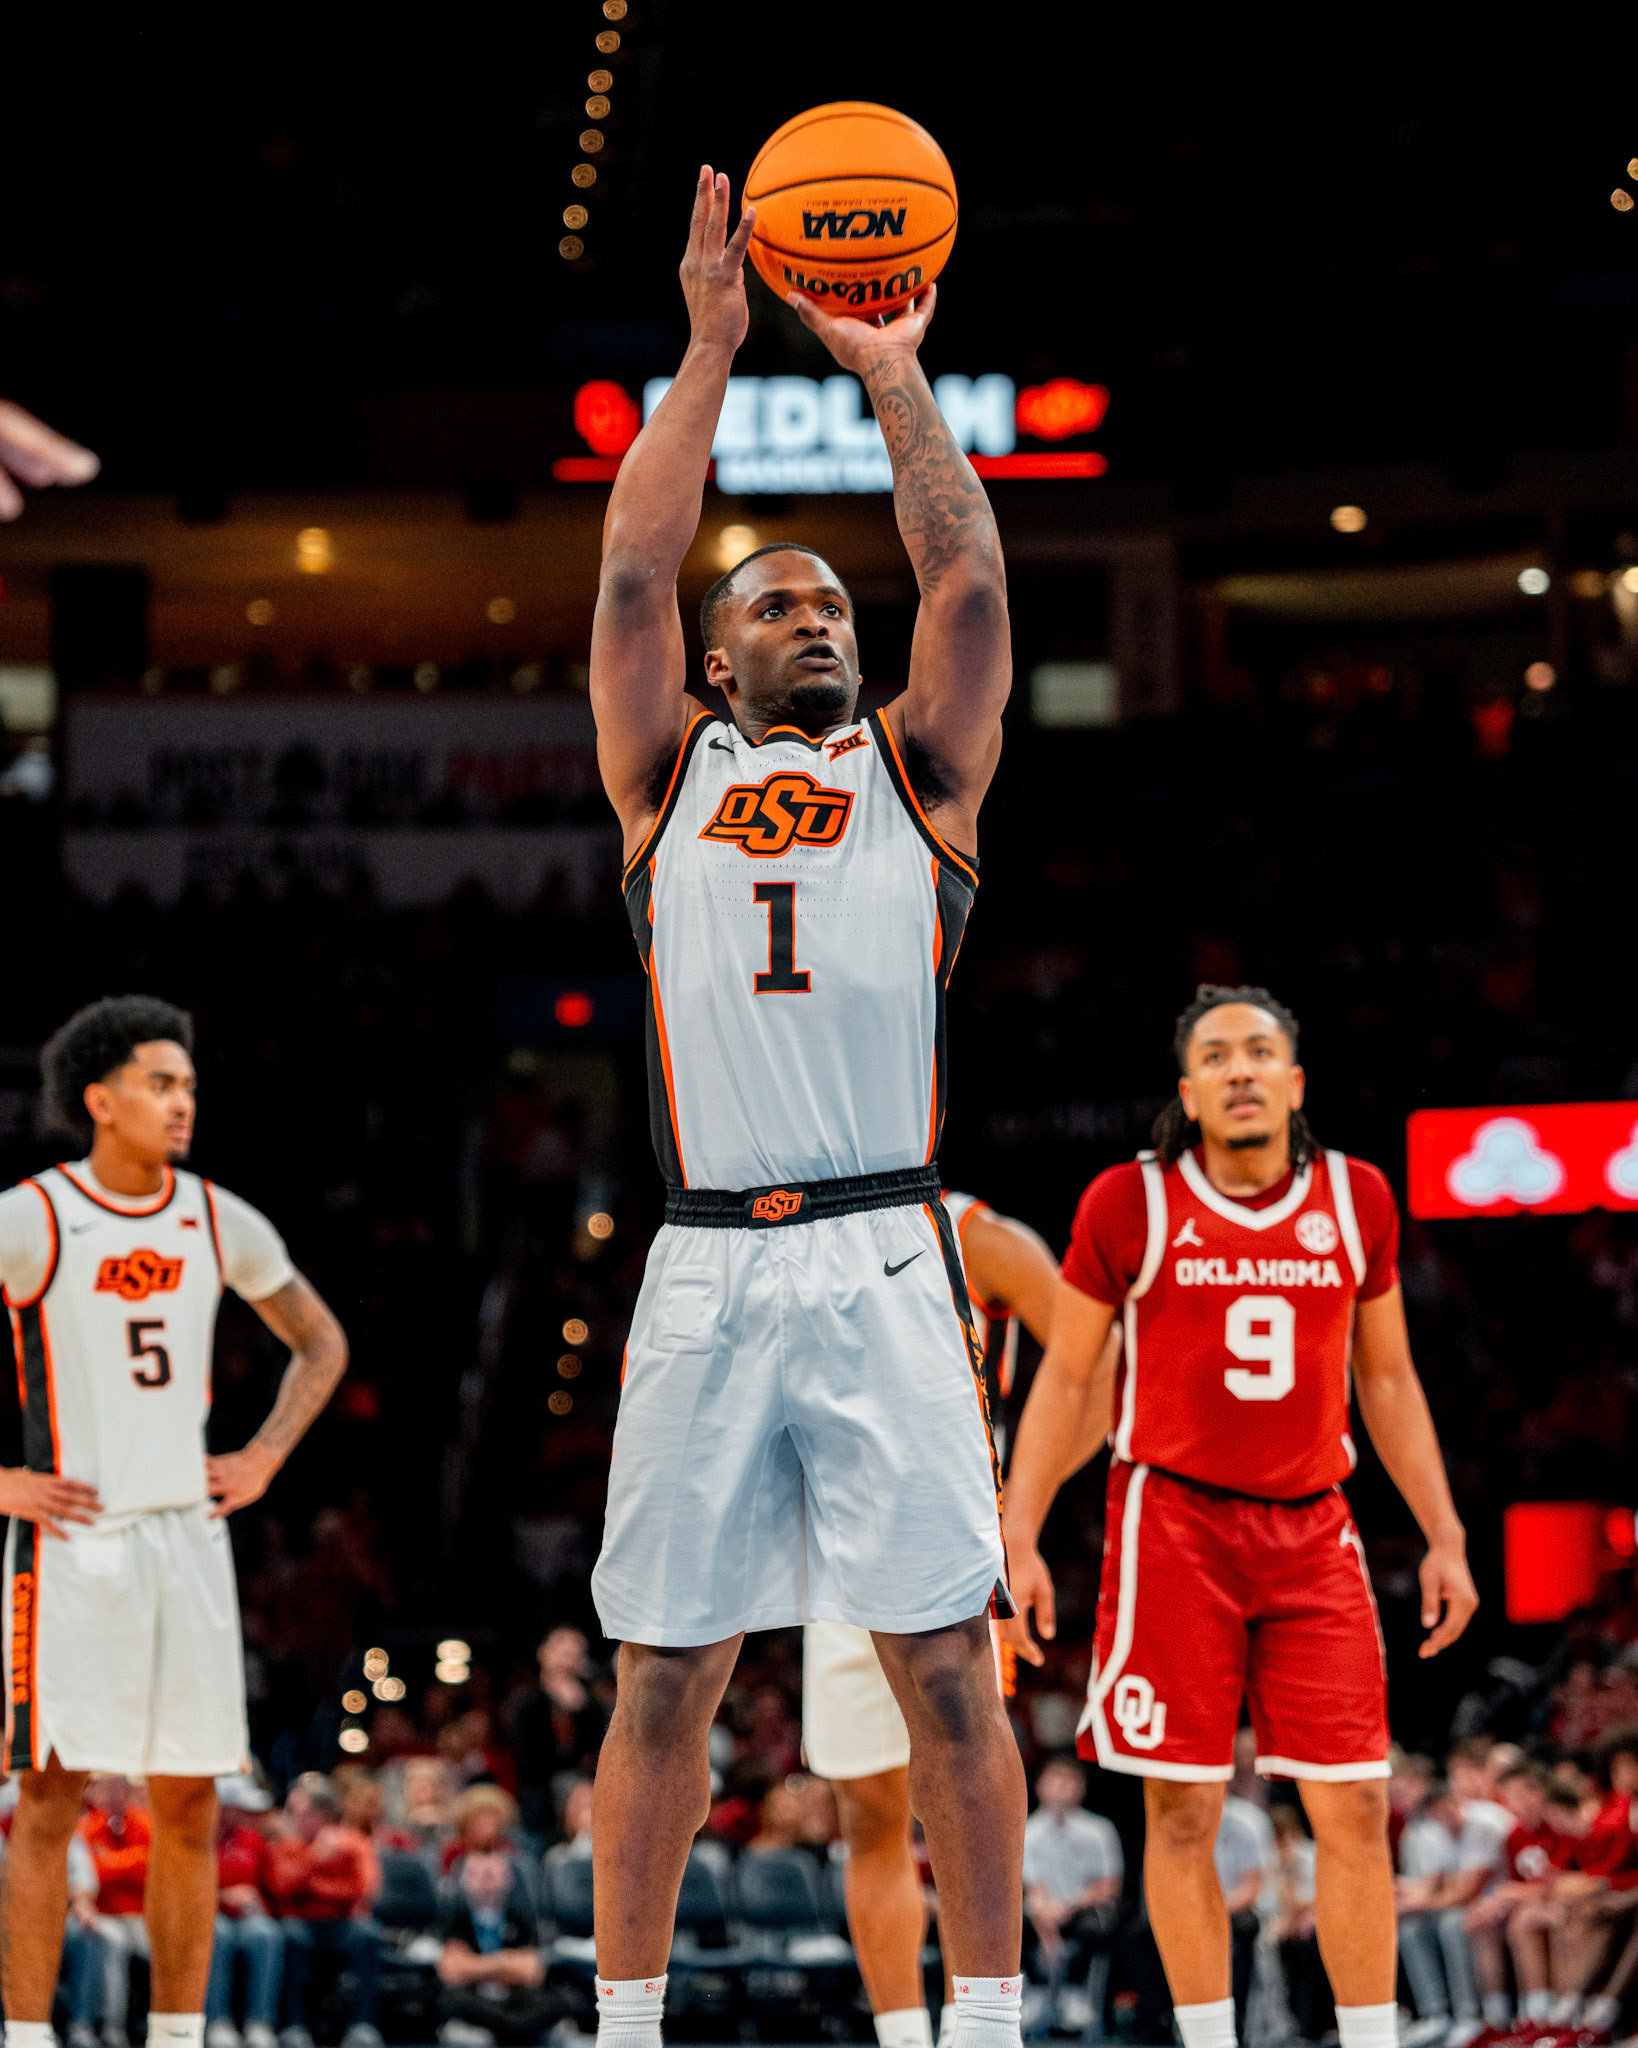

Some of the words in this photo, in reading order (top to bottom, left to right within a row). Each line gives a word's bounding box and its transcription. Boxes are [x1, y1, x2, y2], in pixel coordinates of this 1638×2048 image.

[802, 207, 907, 239] NCAA
[783, 265, 922, 305] Wilson
[643, 374, 1017, 456] EDLM
[698, 771, 855, 858] OSU
[753, 882, 811, 994] 1
[752, 1190, 803, 1221] OSU
[94, 1250, 185, 1301] OSU
[1175, 1258, 1342, 1288] OKLAHOMA
[126, 1318, 171, 1388] 5
[1224, 1295, 1296, 1402] 9
[1113, 1674, 1167, 1751] OU
